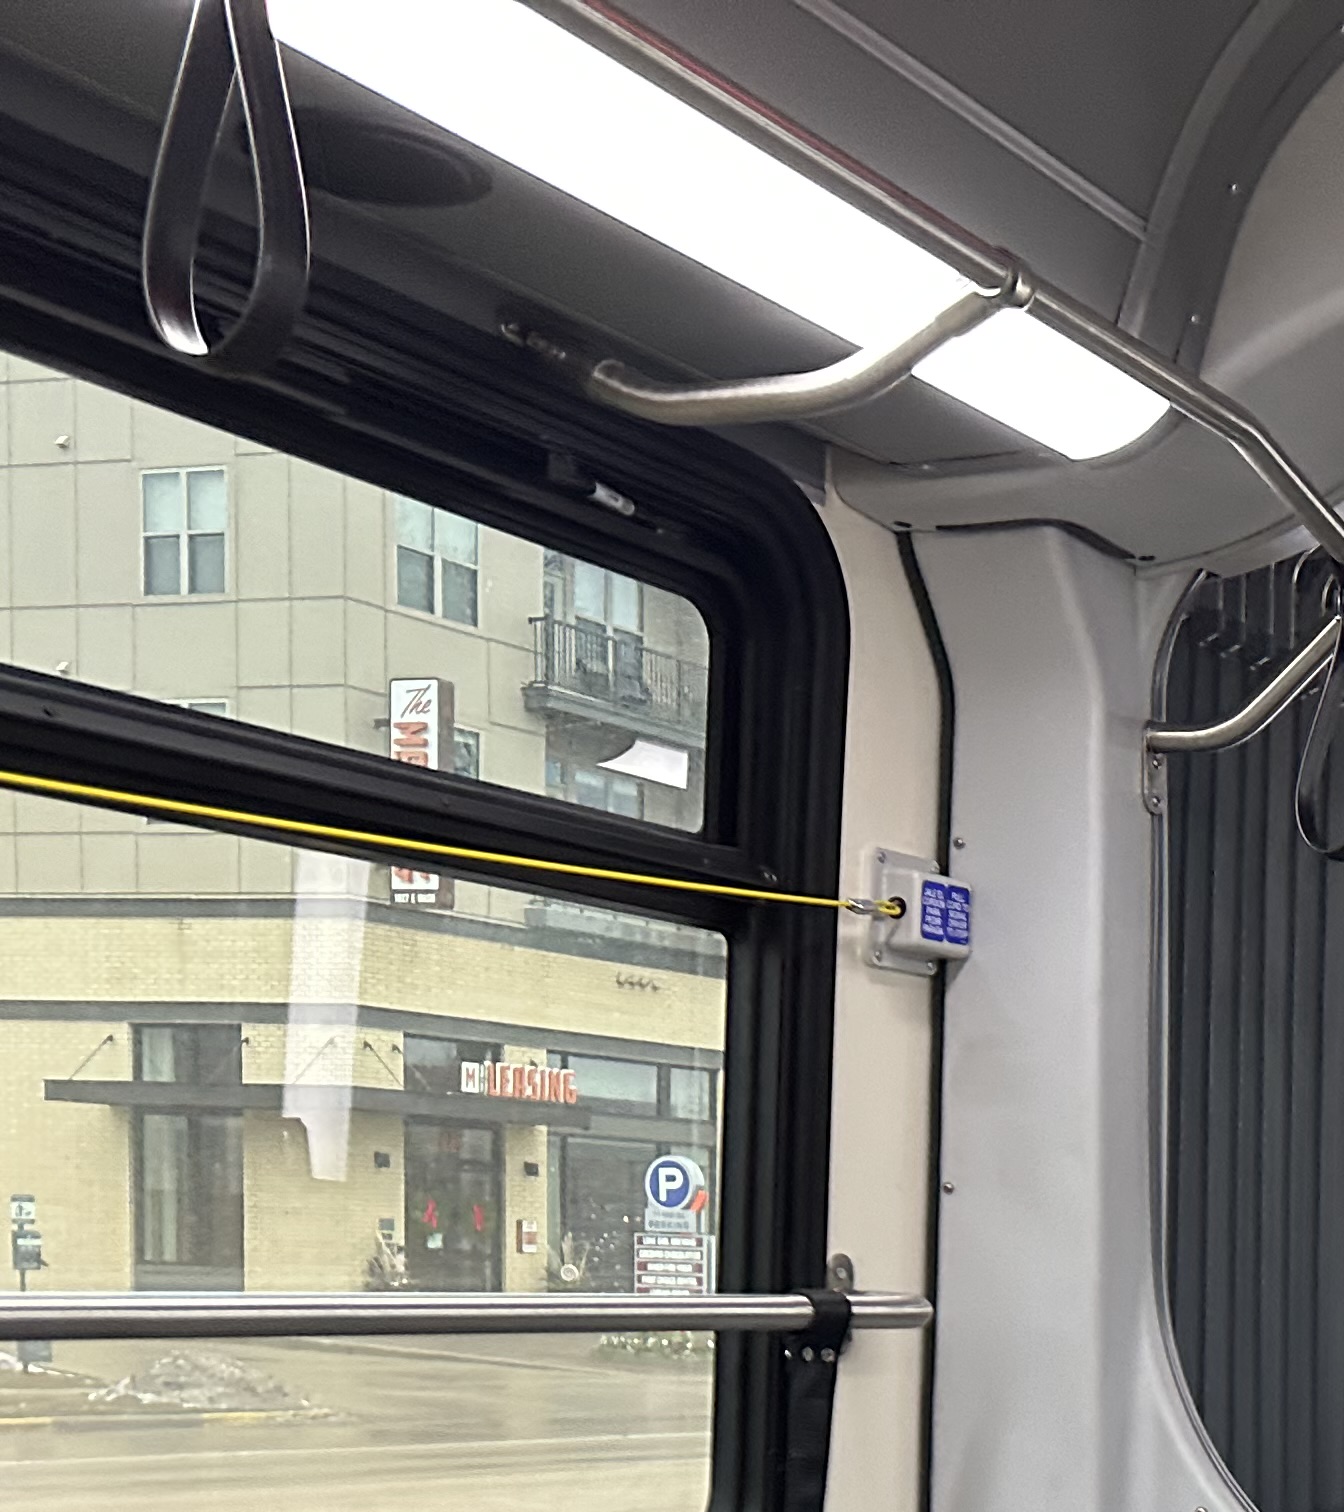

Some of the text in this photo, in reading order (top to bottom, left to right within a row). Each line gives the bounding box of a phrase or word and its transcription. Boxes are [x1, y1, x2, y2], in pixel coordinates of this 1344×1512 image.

[400, 683, 432, 719] The
[483, 1061, 577, 1105] LEASING
[658, 1167, 684, 1202] P
